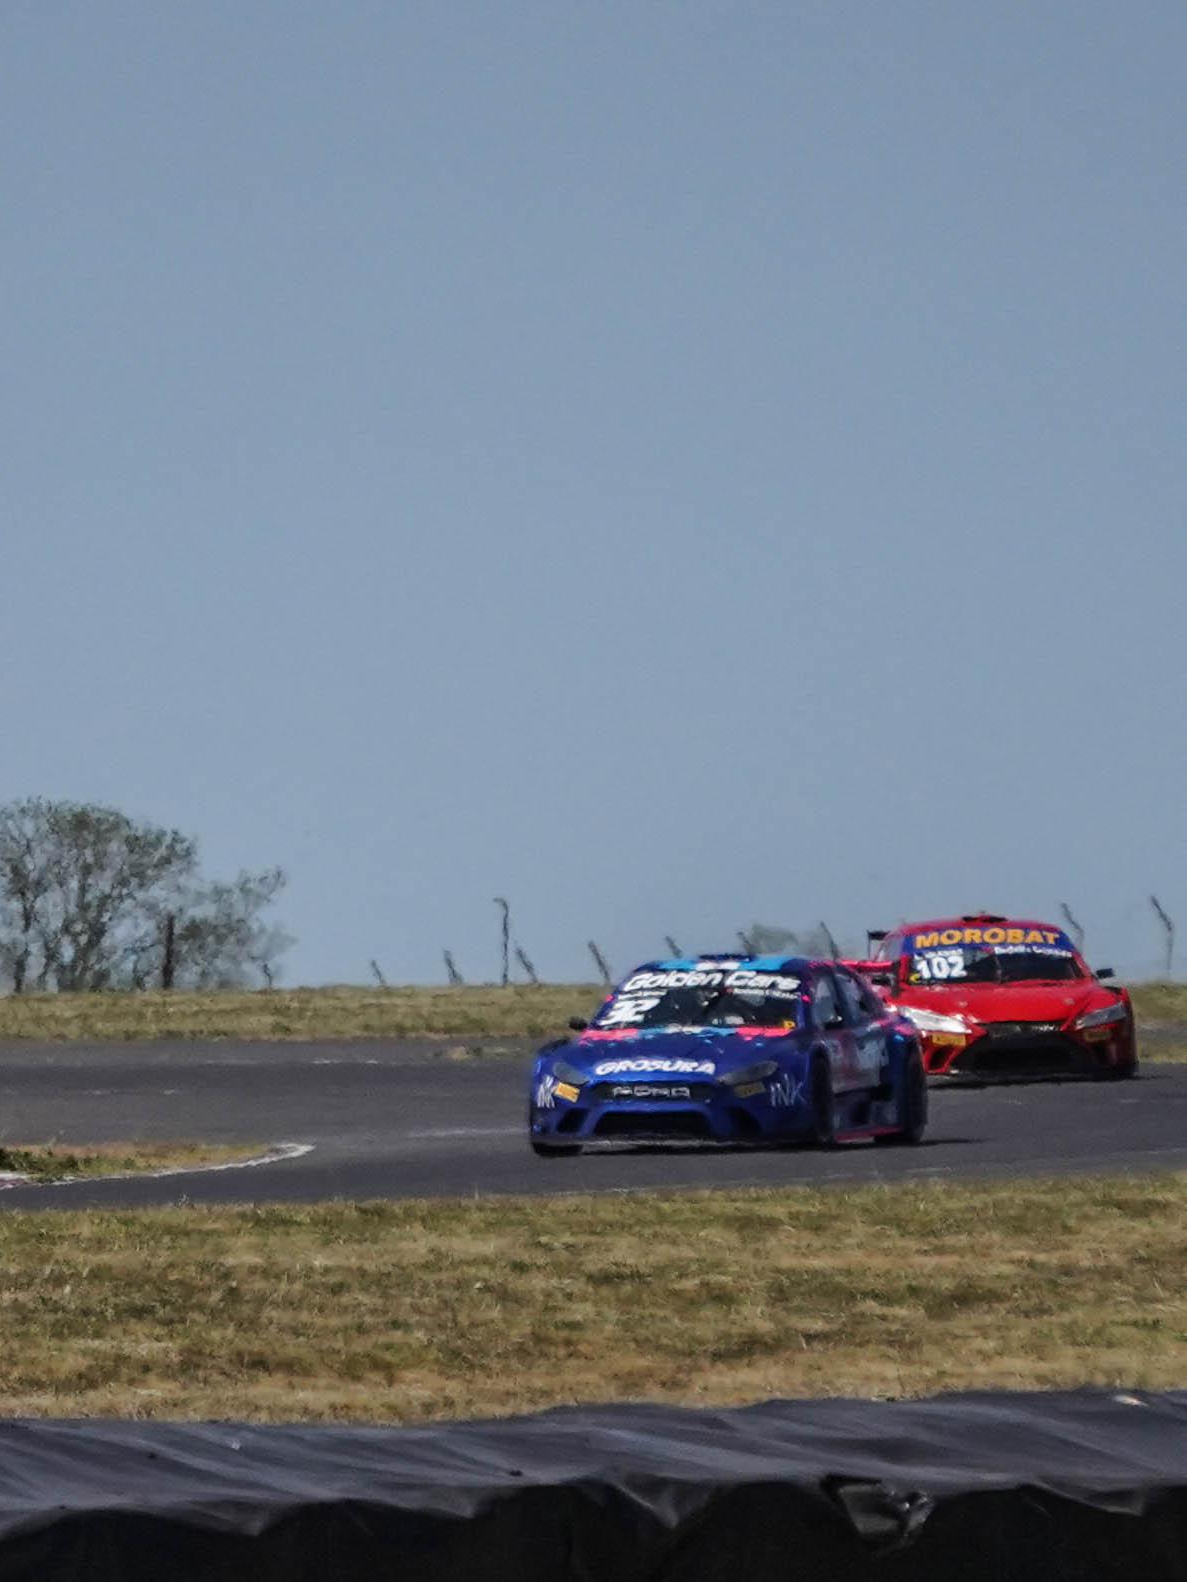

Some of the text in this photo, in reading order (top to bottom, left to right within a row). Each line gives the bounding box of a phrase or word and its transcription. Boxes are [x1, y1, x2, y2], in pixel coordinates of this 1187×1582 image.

[916, 928, 1059, 947] MOROBAT
[917, 955, 967, 979] 102
[626, 971, 801, 991] Golden Cars
[599, 998, 660, 1025] 32
[595, 1059, 715, 1076] GROSURA
